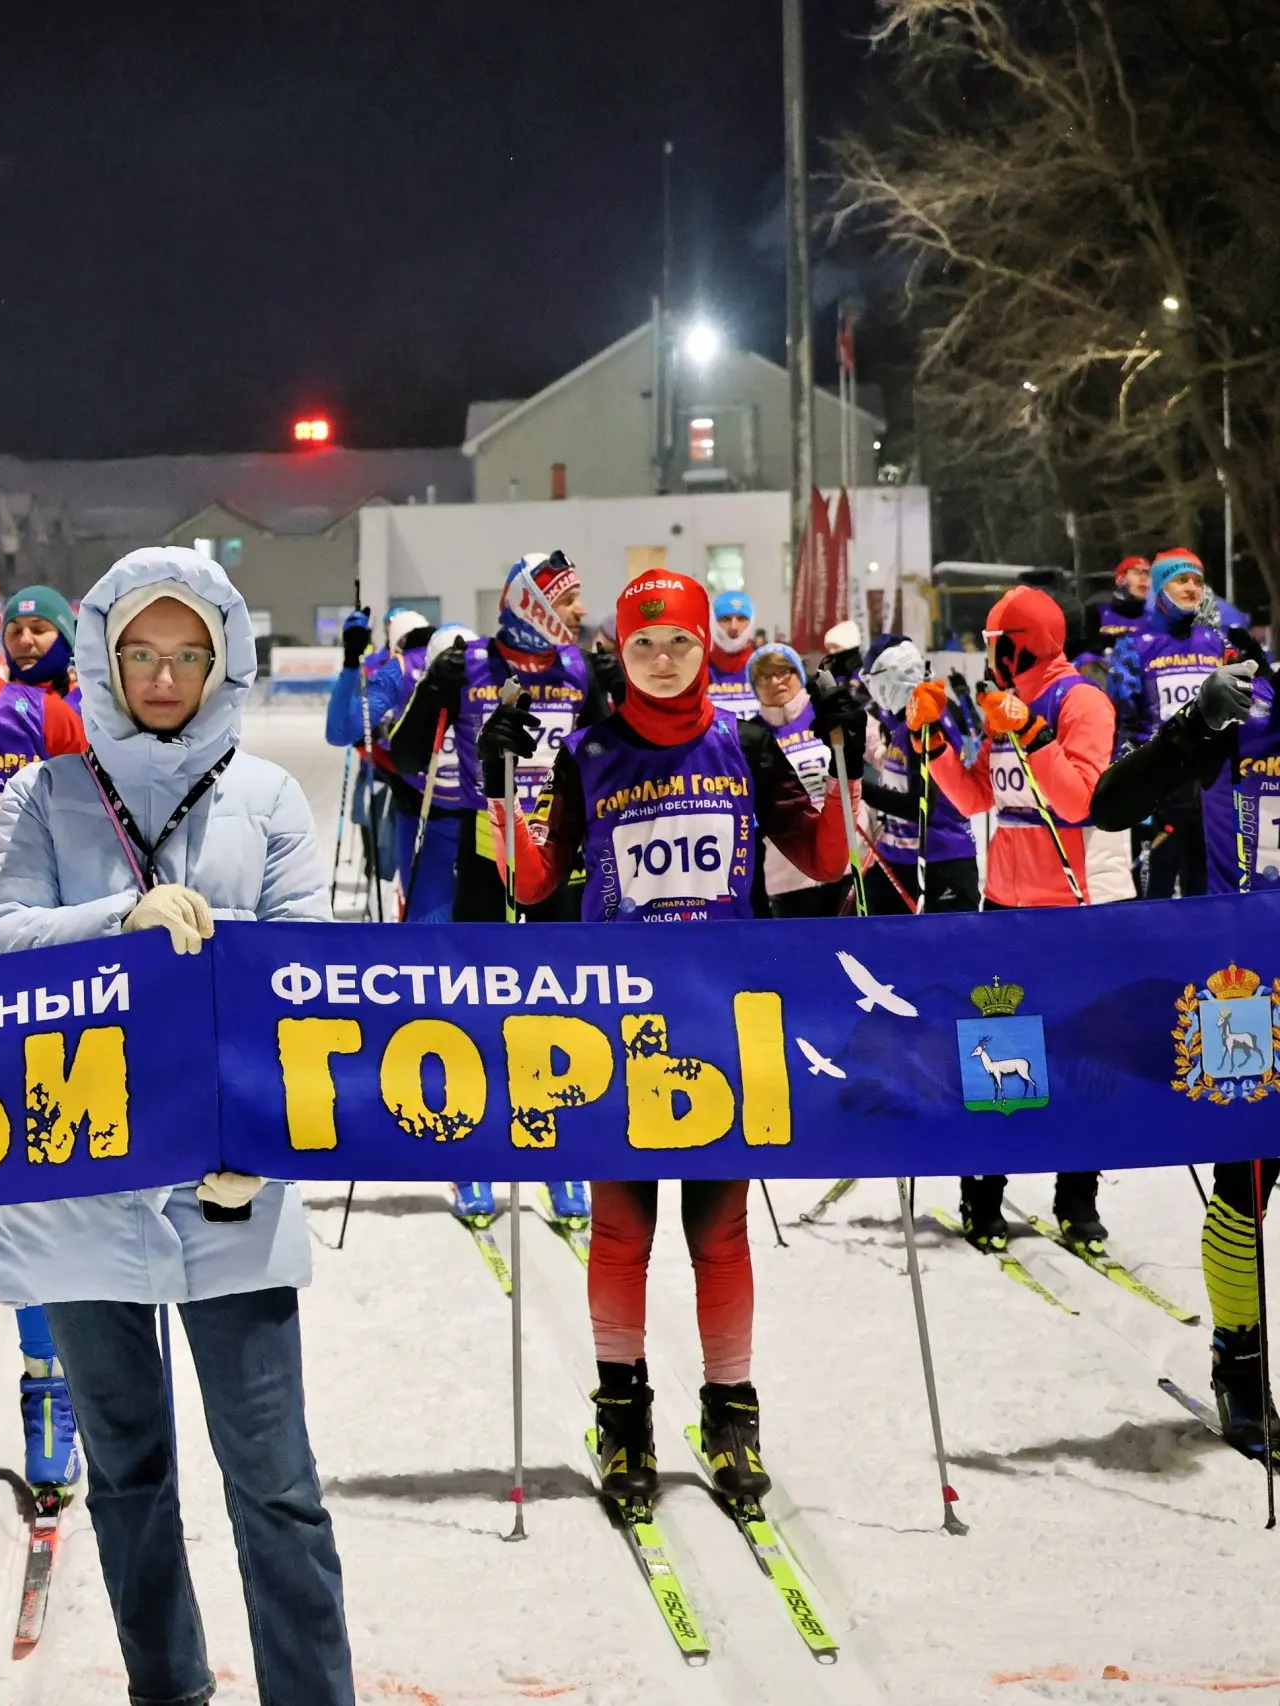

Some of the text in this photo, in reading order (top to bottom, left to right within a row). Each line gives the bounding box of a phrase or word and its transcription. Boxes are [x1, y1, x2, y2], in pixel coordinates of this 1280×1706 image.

[625, 579, 684, 599] RUSSIA
[596, 774, 749, 819] СОКОЛЬИ ГОРЫ
[665, 799, 733, 812] ФЕСТИВАЛЬ
[627, 835, 721, 878] 1016
[643, 911, 708, 923] VOLGAMAN
[652, 901, 685, 909] САМАРА
[270, 962, 654, 1005] ФЕСТИВАЛЬ
[276, 989, 793, 1151] ГОРЫ
[659, 1588, 698, 1639] FISCHER
[780, 1587, 825, 1637] FISCHER
